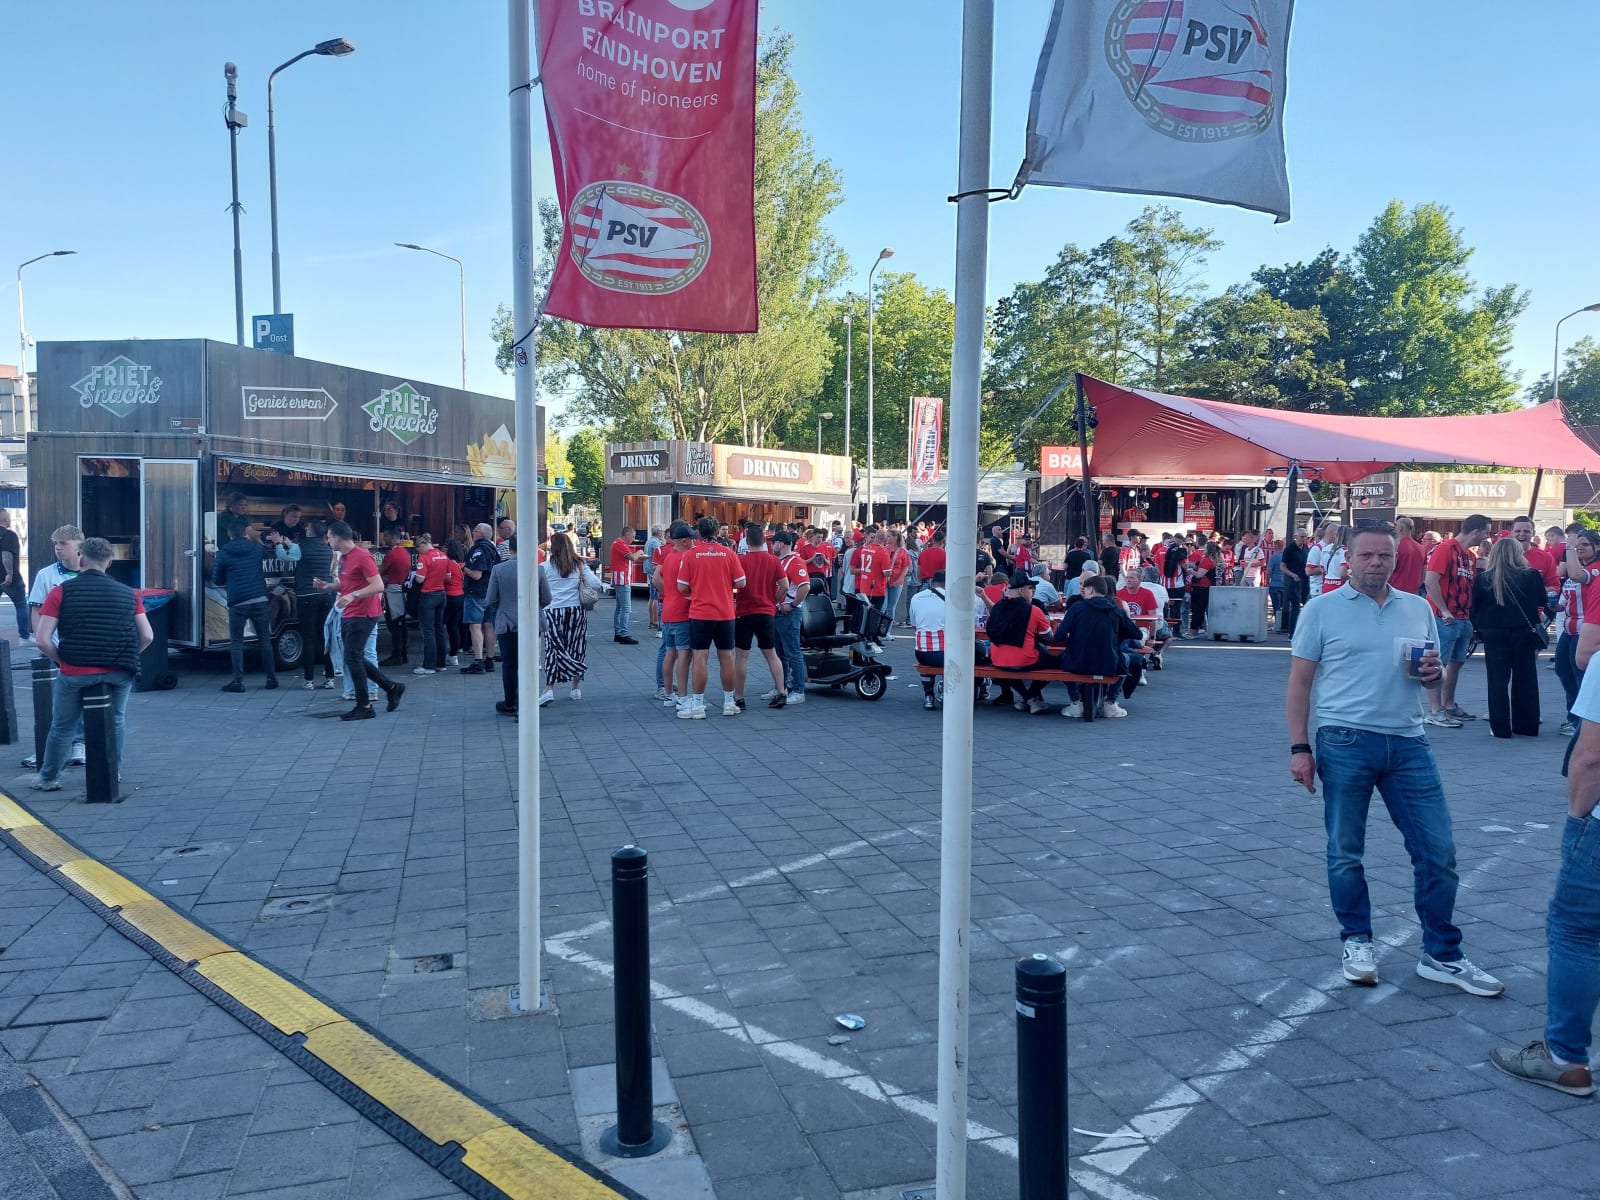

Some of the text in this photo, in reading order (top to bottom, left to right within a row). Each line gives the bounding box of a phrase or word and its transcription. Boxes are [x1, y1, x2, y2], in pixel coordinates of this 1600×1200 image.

[579, 0, 726, 50] BRAINPORT
[1183, 19, 1252, 65] PSV
[582, 26, 722, 84] EINDHOVEN
[577, 55, 718, 110] home of pioneers
[1177, 125, 1230, 139] EST 1913
[606, 219, 659, 248] PSV
[617, 279, 634, 289] EST
[256, 319, 288, 343] P Oost
[91, 365, 152, 386] FRIET
[80, 381, 161, 409] Snacks
[248, 393, 288, 413] Geniet
[380, 388, 431, 416] FRIET
[370, 403, 437, 435] Snacks
[620, 453, 660, 469] DRINKS
[743, 458, 800, 479] DRINKS
[1048, 453, 1091, 469] BRA
[1454, 483, 1507, 498] DRINKS
[860, 553, 873, 573] 12
